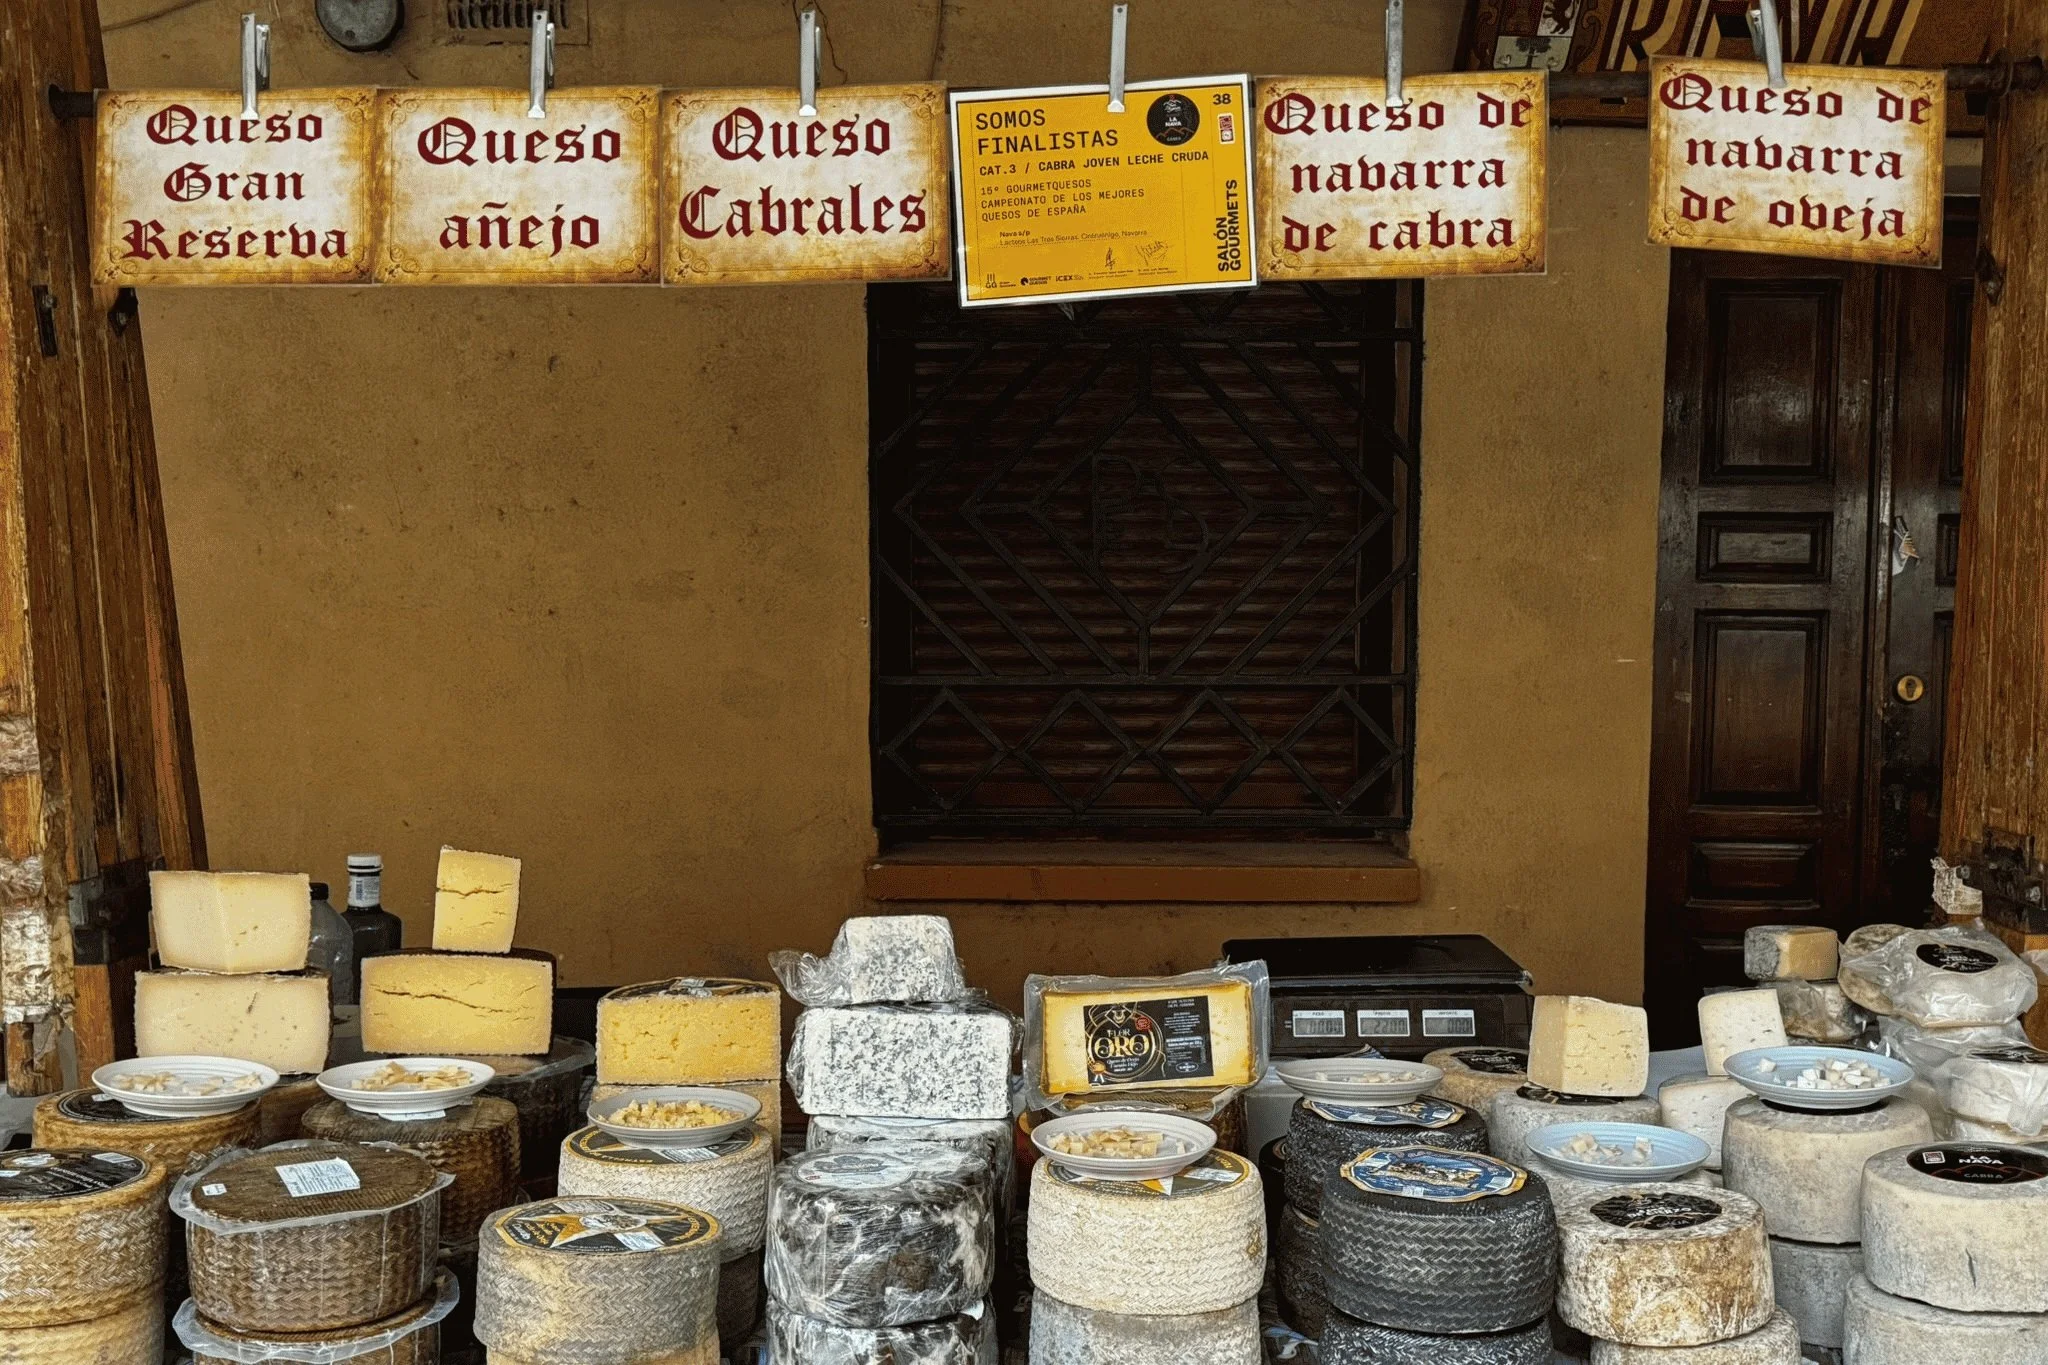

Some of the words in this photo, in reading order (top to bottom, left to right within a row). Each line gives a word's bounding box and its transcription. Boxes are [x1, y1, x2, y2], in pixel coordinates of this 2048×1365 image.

[975, 109, 1046, 131] SOMOS
[1213, 93, 1231, 105] 38
[1263, 92, 1445, 136] Queso
[1476, 91, 1533, 129] de
[1659, 72, 1844, 119] Queso
[1876, 86, 1933, 125] de
[145, 103, 324, 147] Queso
[416, 116, 622, 168] Queso
[712, 106, 891, 162] Queso
[978, 130, 1119, 155] FINALISTAS
[979, 164, 1017, 176] CAT.3
[1038, 159, 1076, 172] CABRA
[1083, 156, 1120, 169] JOVEN
[1127, 153, 1164, 166] LECHE
[1172, 150, 1209, 163] CRUDA
[1290, 155, 1508, 194] navarra
[1685, 135, 1905, 180] navarra
[163, 161, 306, 203] Gran
[981, 195, 1047, 210] CAMPEONATO
[1053, 194, 1067, 204] DE
[1072, 191, 1092, 202] LOS
[1099, 188, 1145, 200] MEJORES
[1006, 179, 1092, 194] GOURMETQUESOS
[438, 201, 602, 258] añejo
[678, 182, 928, 240] Cabrales
[981, 210, 1021, 222] QUESOS
[1027, 208, 1041, 219] DE
[1047, 205, 1087, 217] ESPAÑA
[1226, 179, 1242, 271] GOURMETS
[1281, 215, 1337, 253] de
[1368, 209, 1517, 251] cabra
[1680, 185, 1736, 224] de
[1767, 194, 1907, 242] oveja
[121, 218, 350, 261] Reserva
[1215, 217, 1229, 273] SALÓN
[1094, 1034, 1150, 1059] ORO
